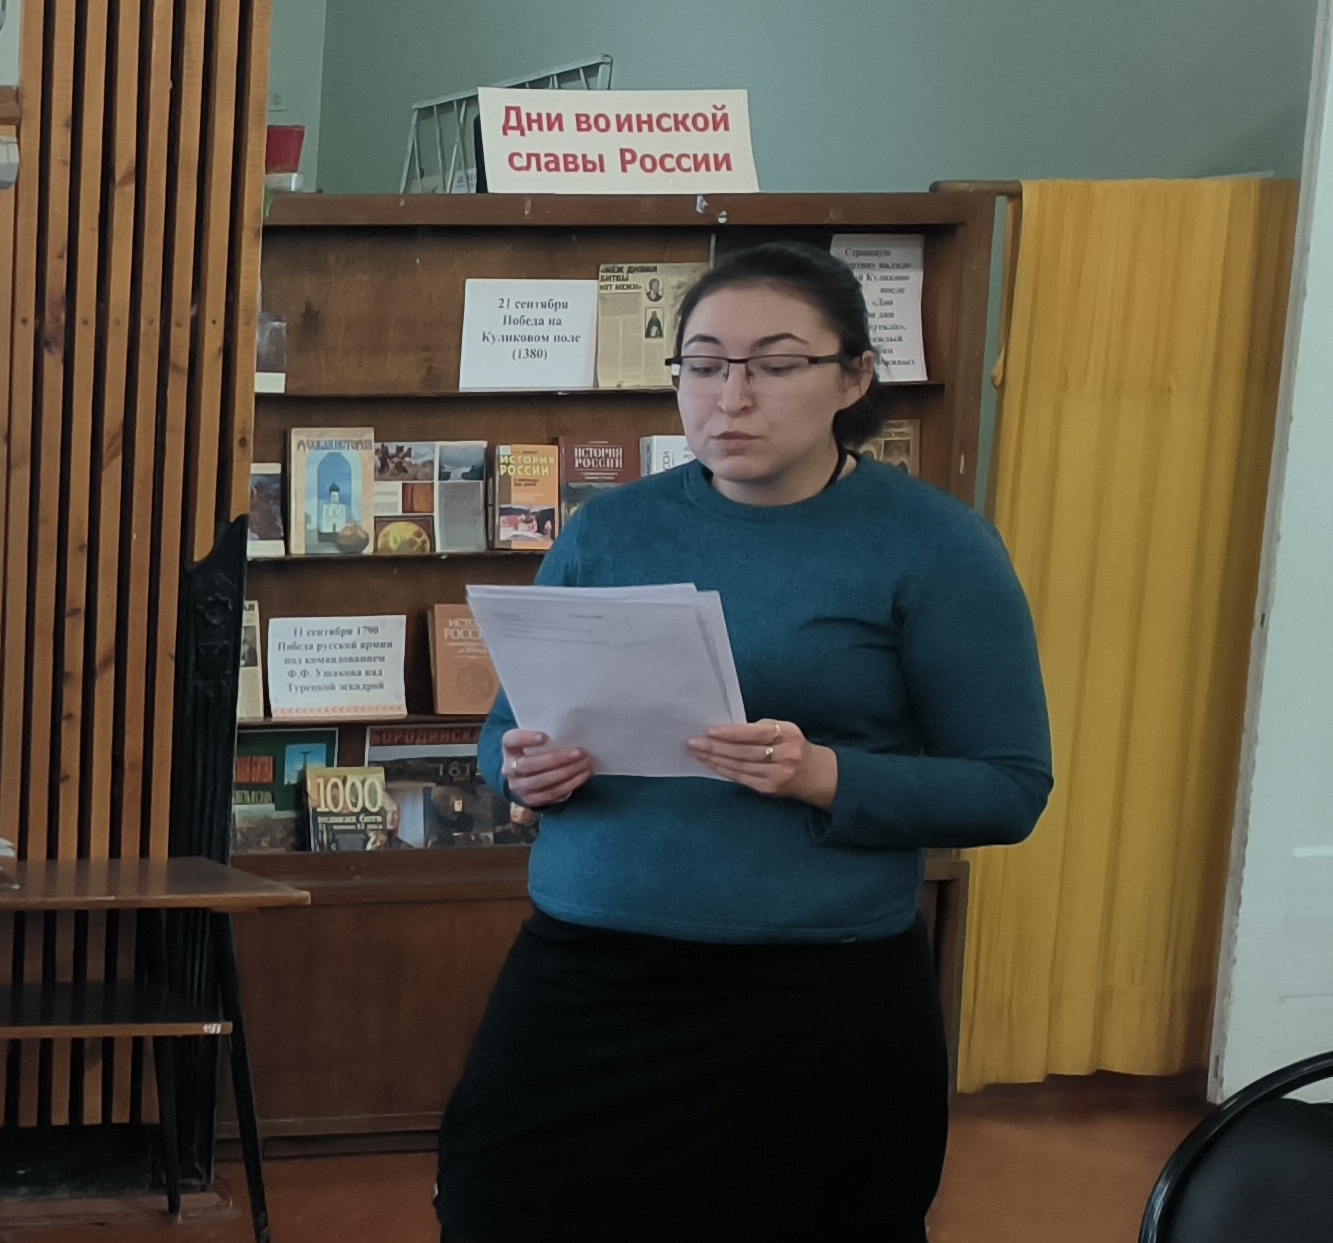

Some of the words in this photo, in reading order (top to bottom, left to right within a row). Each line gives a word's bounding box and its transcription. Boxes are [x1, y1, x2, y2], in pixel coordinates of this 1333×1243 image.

[502, 106, 564, 137] Дни
[575, 104, 730, 133] воинской
[508, 151, 605, 173] славы
[619, 148, 733, 173] России
[498, 298, 511, 310] 21
[514, 298, 569, 312] сентября
[502, 315, 545, 327] Победа
[548, 317, 562, 327] на
[482, 332, 550, 348] Куликовом
[553, 334, 582, 344] поле
[511, 348, 548, 361] (1380)
[574, 447, 623, 458] ИСТОРИЯ
[499, 455, 555, 464] ИСТОРИЯ
[574, 457, 623, 468] РОССИИ
[499, 464, 549, 476] РОССИИ
[307, 626, 353, 638] сентября
[278, 642, 314, 652] Победа
[316, 641, 357, 652] русской
[287, 682, 336, 694] Турецкой
[438, 761, 482, 777] 181
[316, 777, 382, 813] 1000
